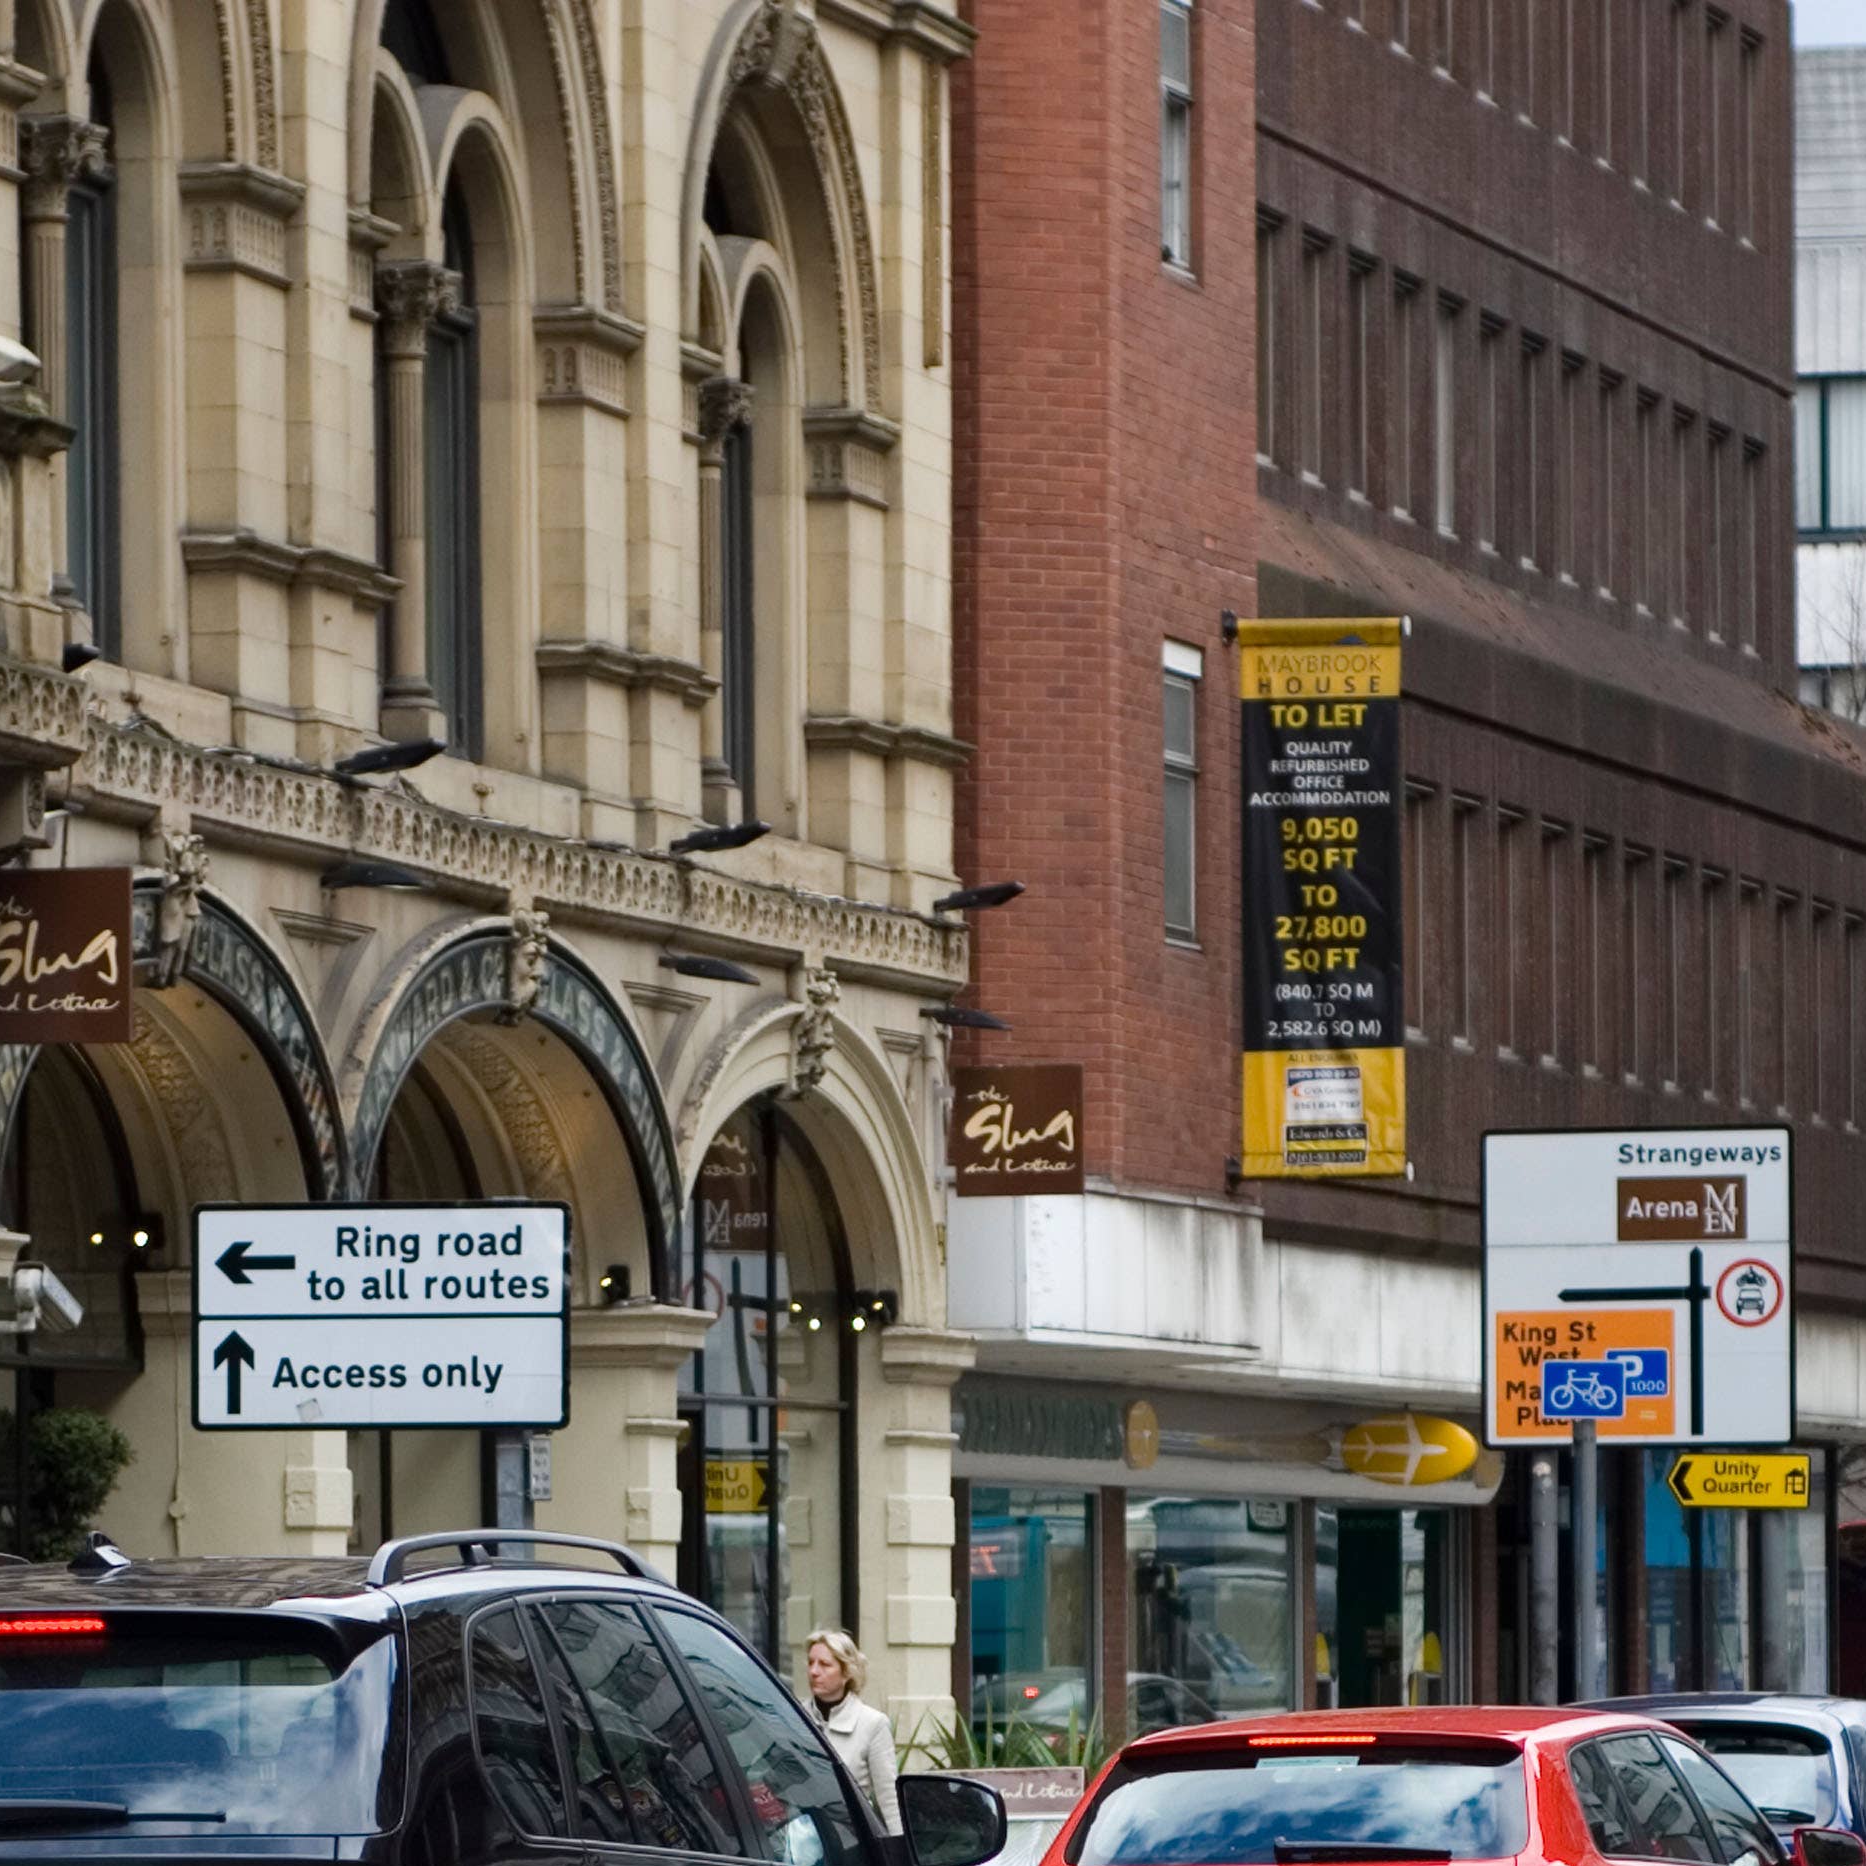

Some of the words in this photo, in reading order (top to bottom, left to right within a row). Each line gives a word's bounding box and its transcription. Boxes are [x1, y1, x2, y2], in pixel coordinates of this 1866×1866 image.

[1257, 654, 1382, 674] MAYBROOK
[1257, 675, 1381, 695] HOUSE
[1271, 704, 1307, 728] TO
[1317, 703, 1368, 728] LET
[1285, 740, 1353, 755] QUALITY
[1270, 758, 1370, 773] REFURBISHED
[1293, 775, 1344, 789] OFFICE
[1249, 791, 1390, 807] ACCOMMODATION
[1282, 817, 1358, 842] 9,050
[1284, 848, 1319, 873] SQ
[1324, 847, 1358, 870] FT
[1301, 884, 1338, 906] TO
[1275, 916, 1367, 941] 27,800
[1284, 949, 1321, 973] SQ
[1326, 948, 1360, 970] FT
[1275, 983, 1324, 1002] (840.7
[1328, 983, 1352, 1001] SQ
[1356, 983, 1373, 998] M
[1314, 1002, 1335, 1017] TO
[1268, 1021, 1328, 1038] 2,582.6
[1333, 1021, 1354, 1037] SQ
[1359, 1020, 1383, 1038] M)
[964, 1103, 1074, 1154] Slug
[1618, 1142, 1782, 1166] Strangeways
[1626, 1196, 1699, 1219] Arena
[336, 1225, 420, 1263] Ring
[437, 1225, 522, 1257] road
[307, 1270, 346, 1300] to
[361, 1269, 408, 1299] all
[424, 1269, 551, 1299] routes
[1503, 1322, 1557, 1345] King
[1569, 1321, 1597, 1341] St
[272, 1357, 407, 1388] Access
[422, 1355, 503, 1394] only
[1631, 1381, 1666, 1393] 1000
[1714, 1460, 1761, 1478] Unity
[1702, 1477, 1772, 1495] Quarter
